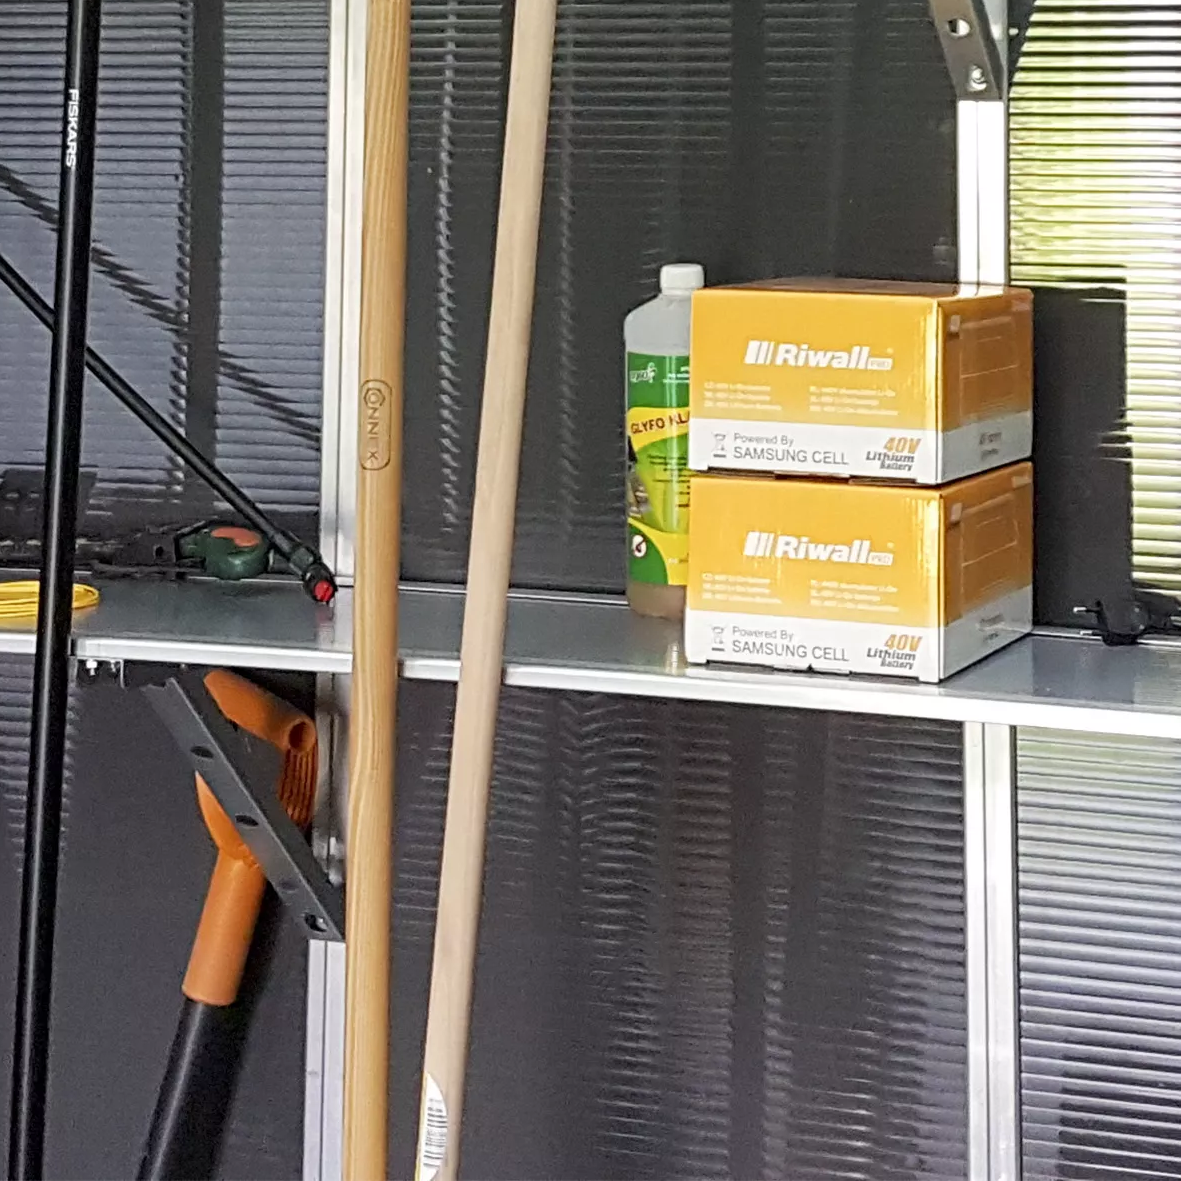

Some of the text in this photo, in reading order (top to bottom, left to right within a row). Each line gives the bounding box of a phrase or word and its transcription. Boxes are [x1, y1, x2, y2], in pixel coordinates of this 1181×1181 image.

[65, 88, 79, 168] FISKARS
[774, 343, 870, 370] Riwall
[733, 433, 794, 447] Powered By
[883, 436, 922, 454] 40V
[733, 446, 849, 465] SAMSUNG CELL
[865, 450, 915, 463] Lithium
[774, 535, 871, 564] Riwall
[732, 626, 794, 642] Powered By
[884, 633, 923, 653] 40V
[732, 640, 850, 662] SAMSUNG CELL
[866, 647, 917, 662] Lithium
